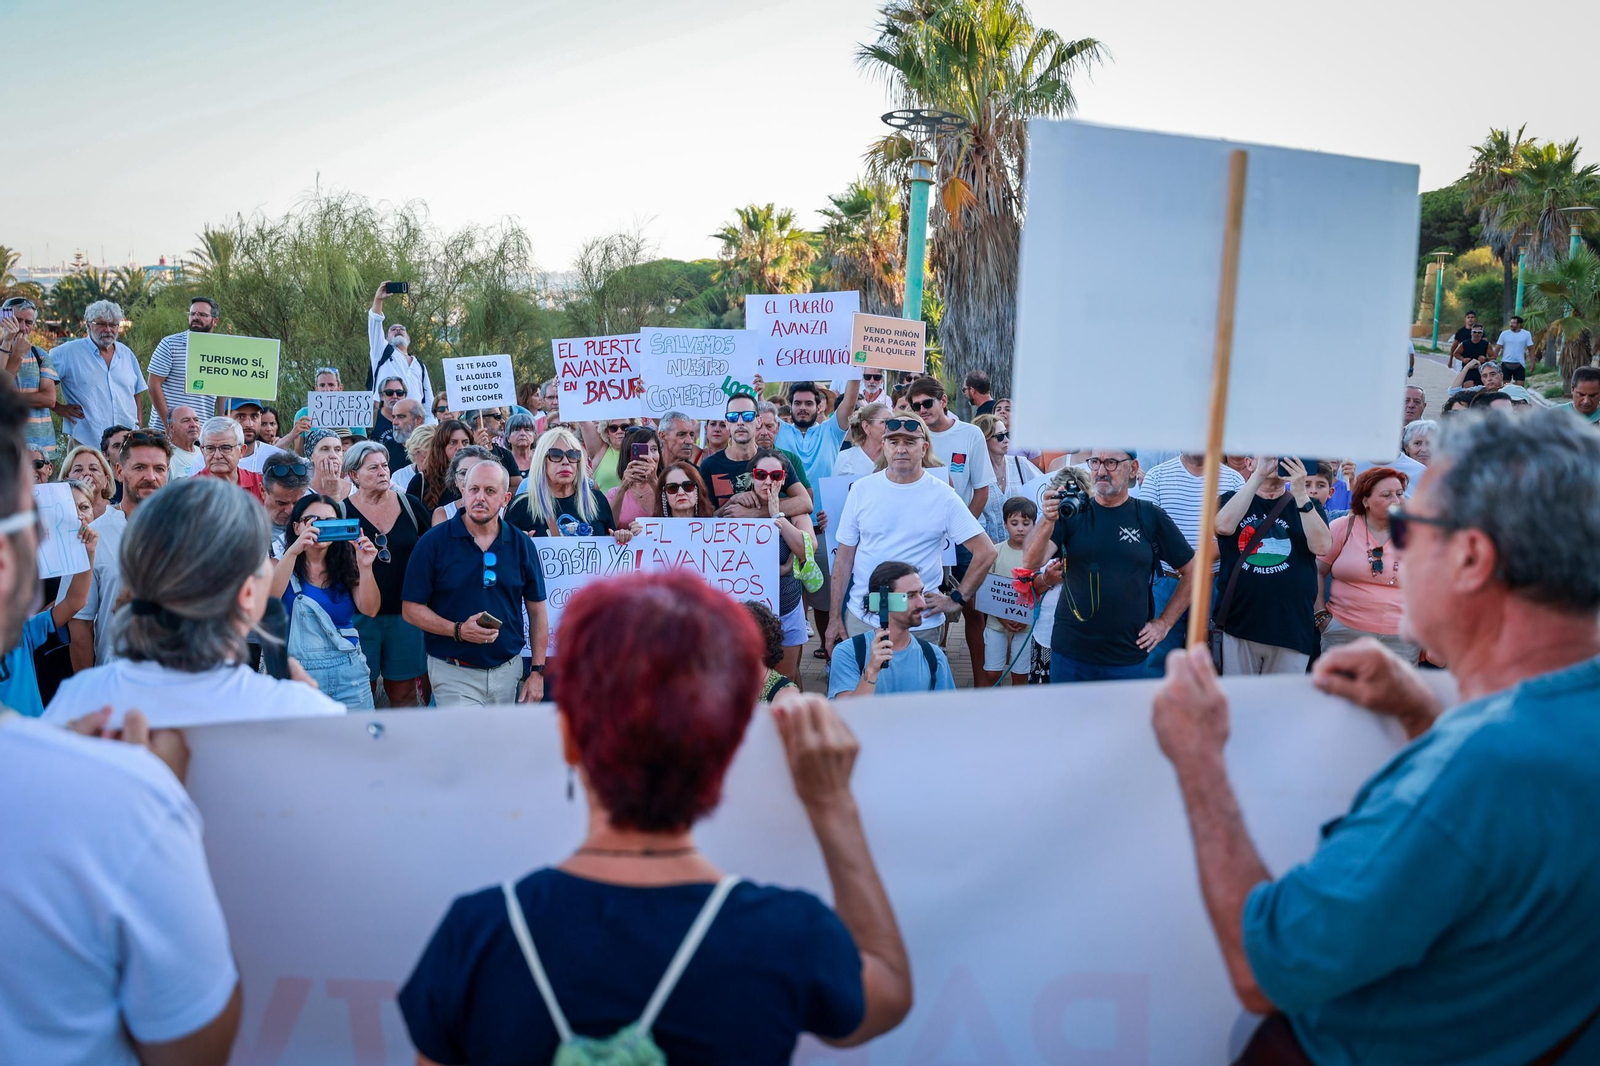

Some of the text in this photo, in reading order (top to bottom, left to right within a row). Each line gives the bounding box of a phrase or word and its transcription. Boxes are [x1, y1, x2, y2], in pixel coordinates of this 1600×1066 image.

[765, 300, 780, 314] EL
[771, 320, 828, 337] AVANZA
[864, 326, 920, 339] VENDO RIÑÓN
[650, 333, 736, 355] SALVEMOS
[863, 335, 917, 348] PARA PAGAR
[558, 343, 579, 359] EL
[875, 346, 915, 356] ALQUILER
[200, 354, 264, 369] TURISMO SÍ,
[561, 356, 632, 378] AVANZA
[667, 357, 729, 377] NUESTRO
[199, 366, 269, 379] PERO NO ASÍ
[466, 371, 502, 380] ALQUILER
[473, 383, 499, 391] QUEDO
[564, 381, 577, 391] EN
[476, 393, 503, 402] COMER
[310, 408, 372, 427] ACÚSTICO
[645, 521, 773, 545] EL PUERTO
[538, 541, 602, 579] BASTA
[653, 547, 755, 574] AVANZA
[1253, 562, 1290, 575] PALESTINA
